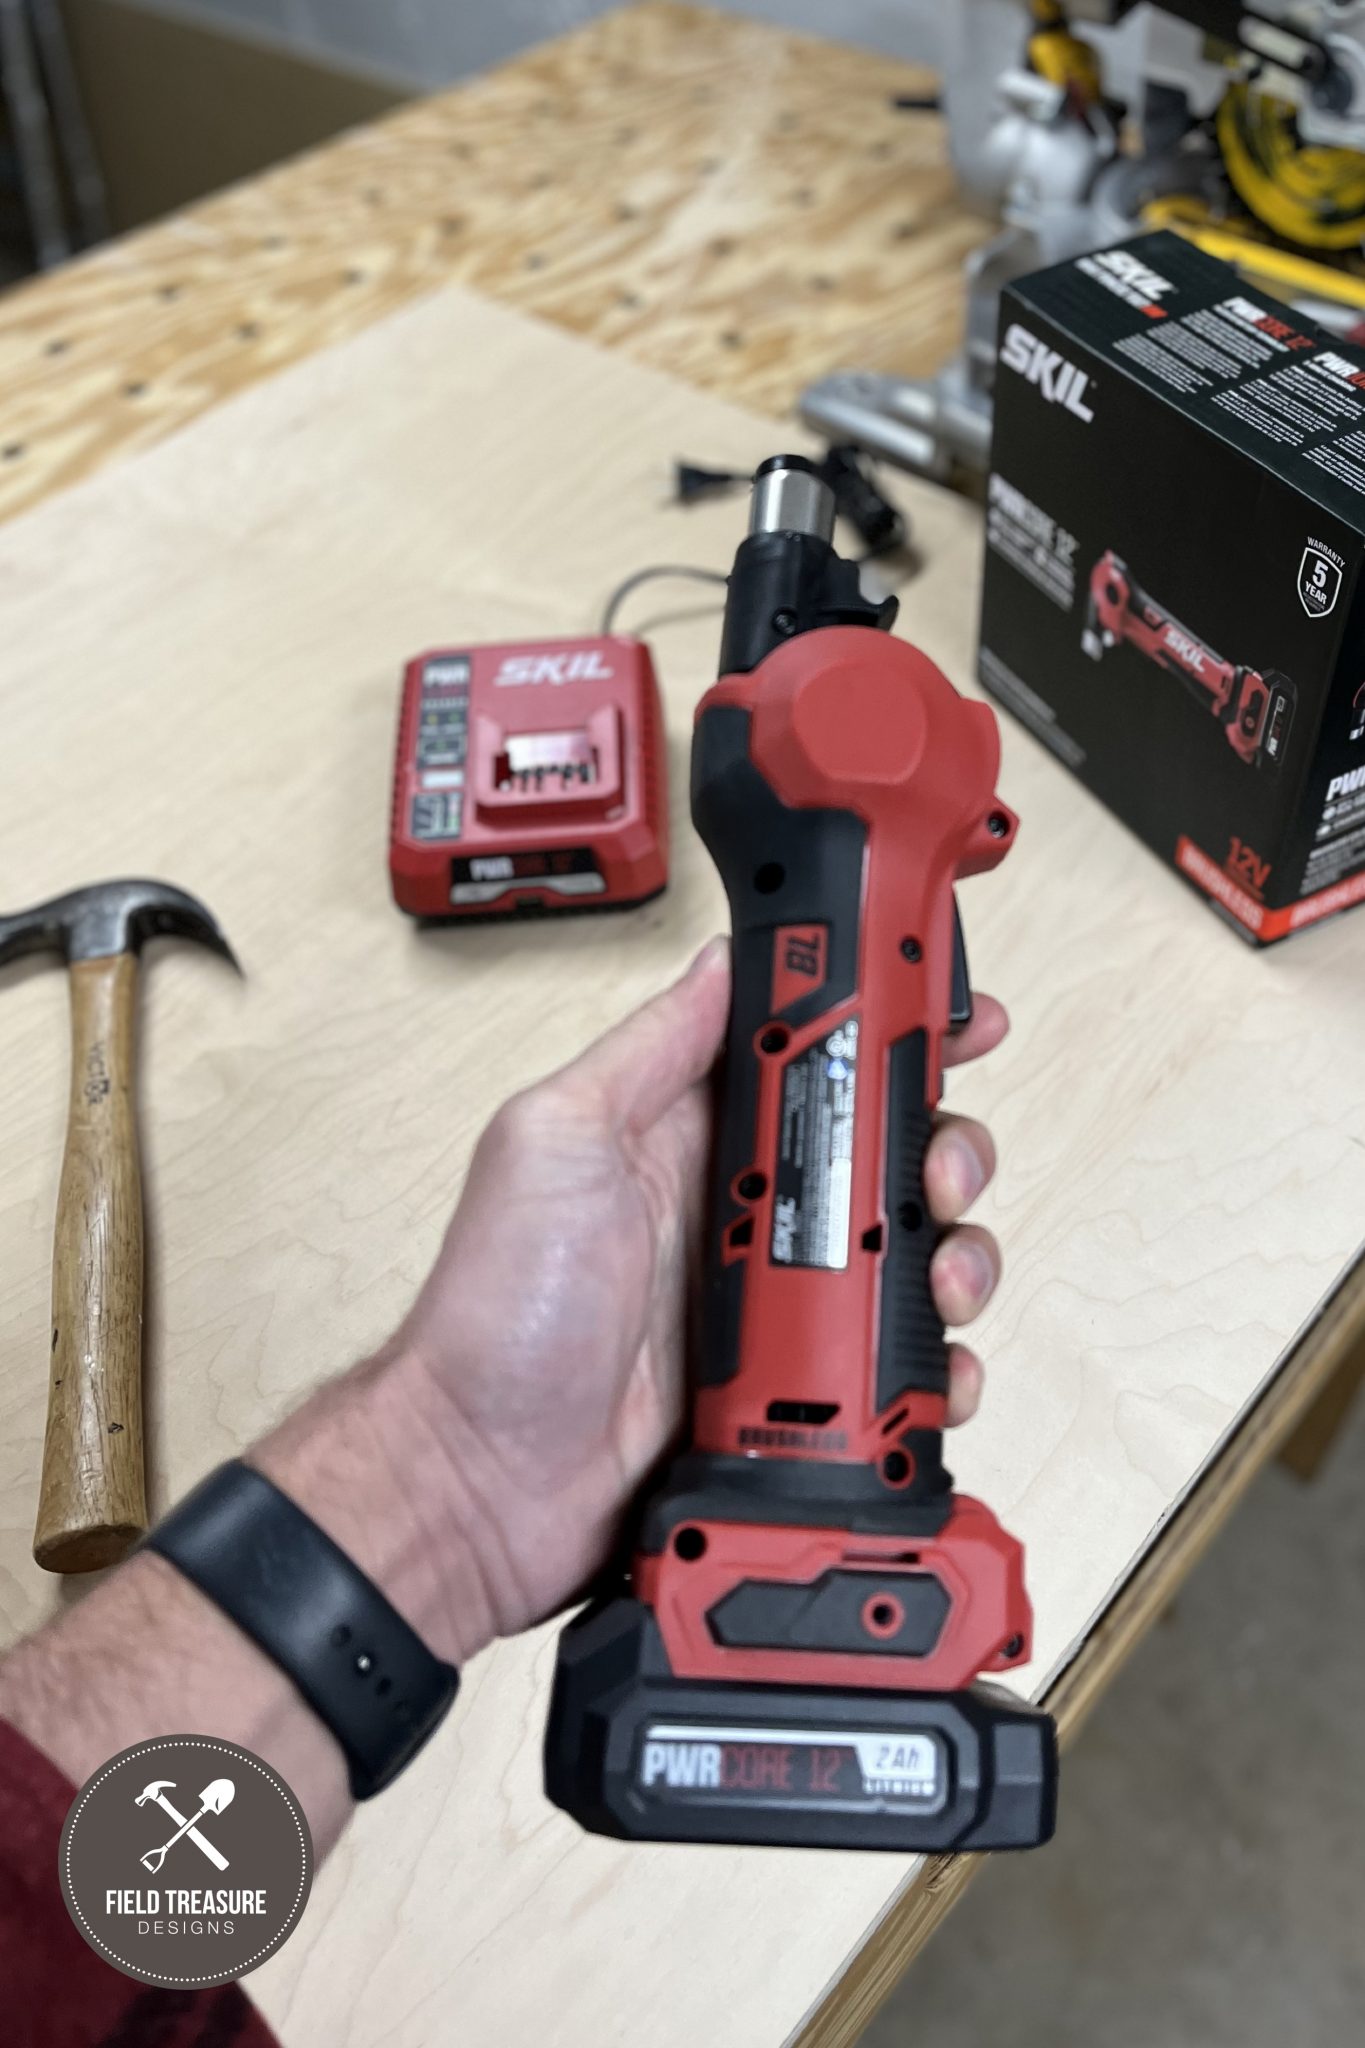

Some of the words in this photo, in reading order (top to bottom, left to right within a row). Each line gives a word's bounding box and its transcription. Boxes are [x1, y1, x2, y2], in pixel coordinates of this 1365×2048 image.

[1091, 250, 1172, 300] SKIL
[1000, 324, 1095, 423] SKIL
[1307, 536, 1345, 568] WARRANTY
[1312, 560, 1329, 588] 5
[1305, 581, 1327, 604] YEAR
[493, 653, 615, 687] SKIL
[1163, 622, 1206, 674] SKIL
[785, 933, 820, 977] BL
[642, 1741, 794, 1791] PWRCORE
[809, 1747, 843, 1792] 12
